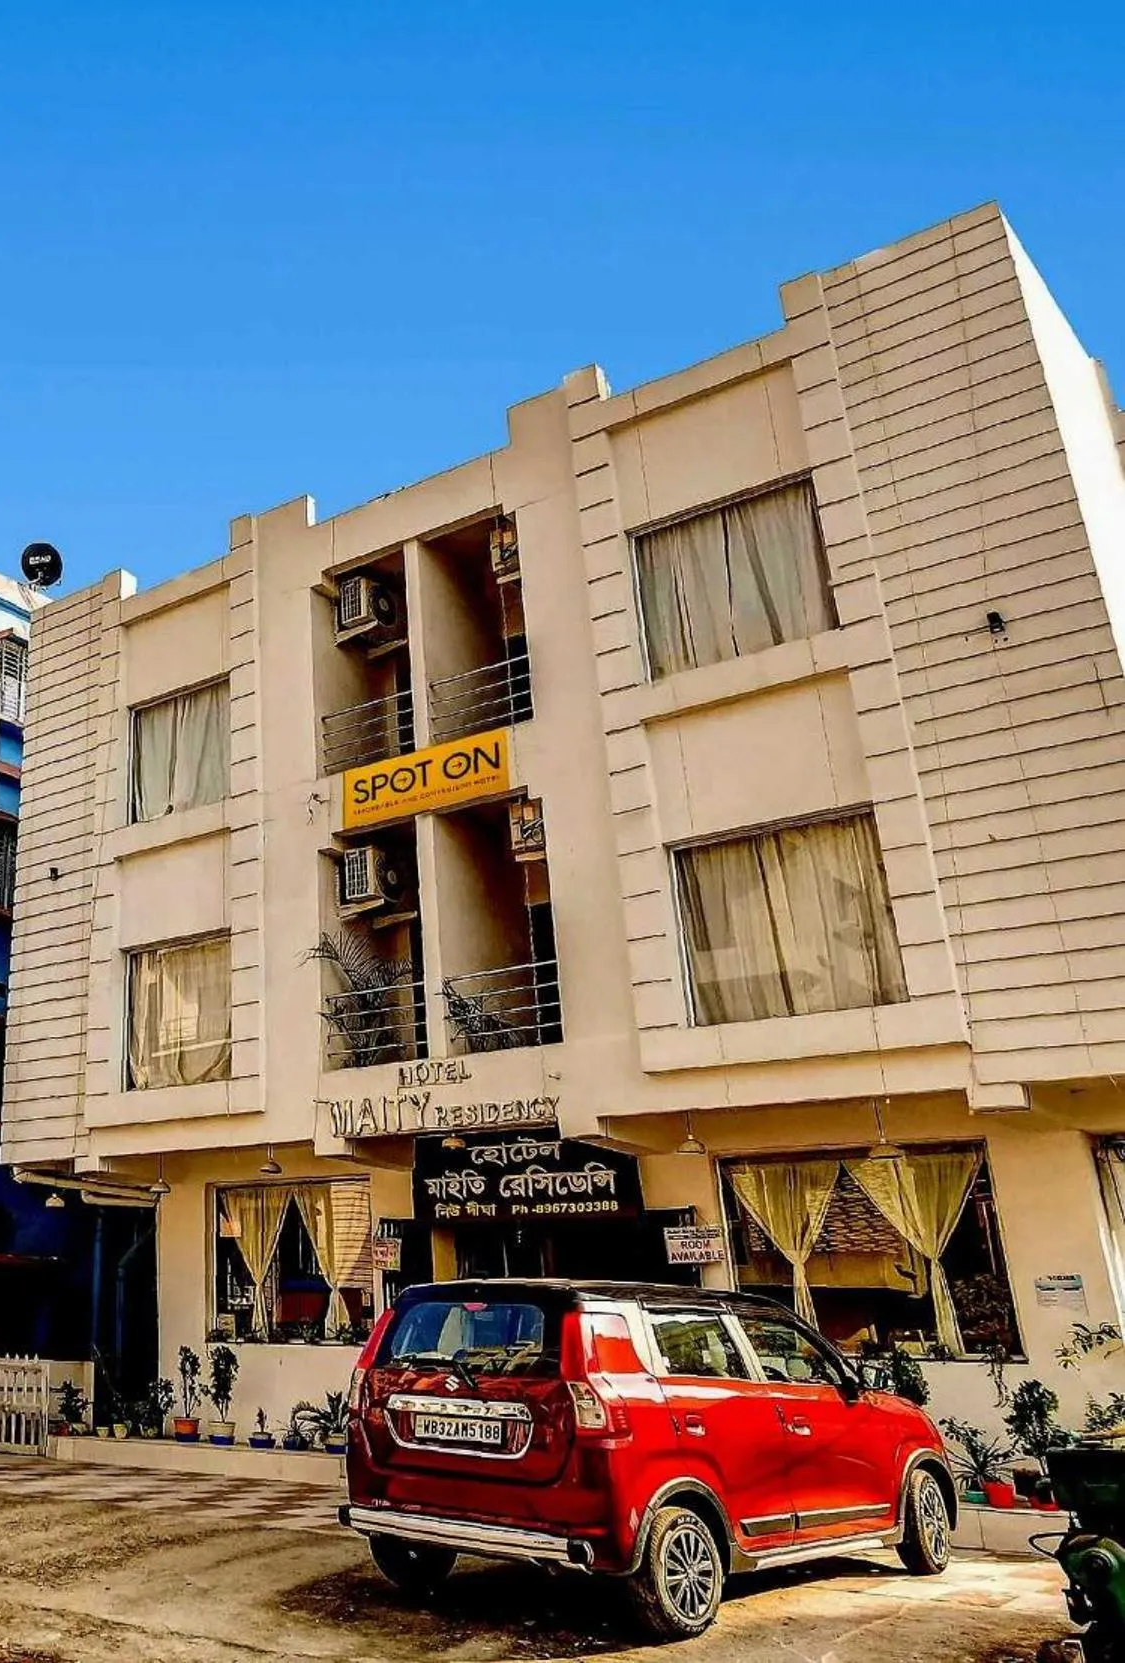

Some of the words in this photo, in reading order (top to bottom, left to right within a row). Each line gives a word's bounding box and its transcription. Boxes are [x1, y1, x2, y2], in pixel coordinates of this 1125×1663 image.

[353, 759, 434, 804] SPOT
[442, 741, 501, 780] ON
[398, 1060, 472, 1086] HOTEL
[329, 1091, 431, 1136] MAITY
[434, 1096, 560, 1128] RESIDENCY
[466, 1136, 562, 1167] হোটেল
[424, 1168, 487, 1201] মাইতি
[499, 1161, 618, 1198] রেসিডেন্সি
[434, 1203, 462, 1219] নিউ
[511, 1204, 529, 1215] Ph
[671, 1250, 725, 1261] AVAILABLE
[680, 1240, 710, 1250] ROOM
[423, 1419, 501, 1440] WB32AM5188
